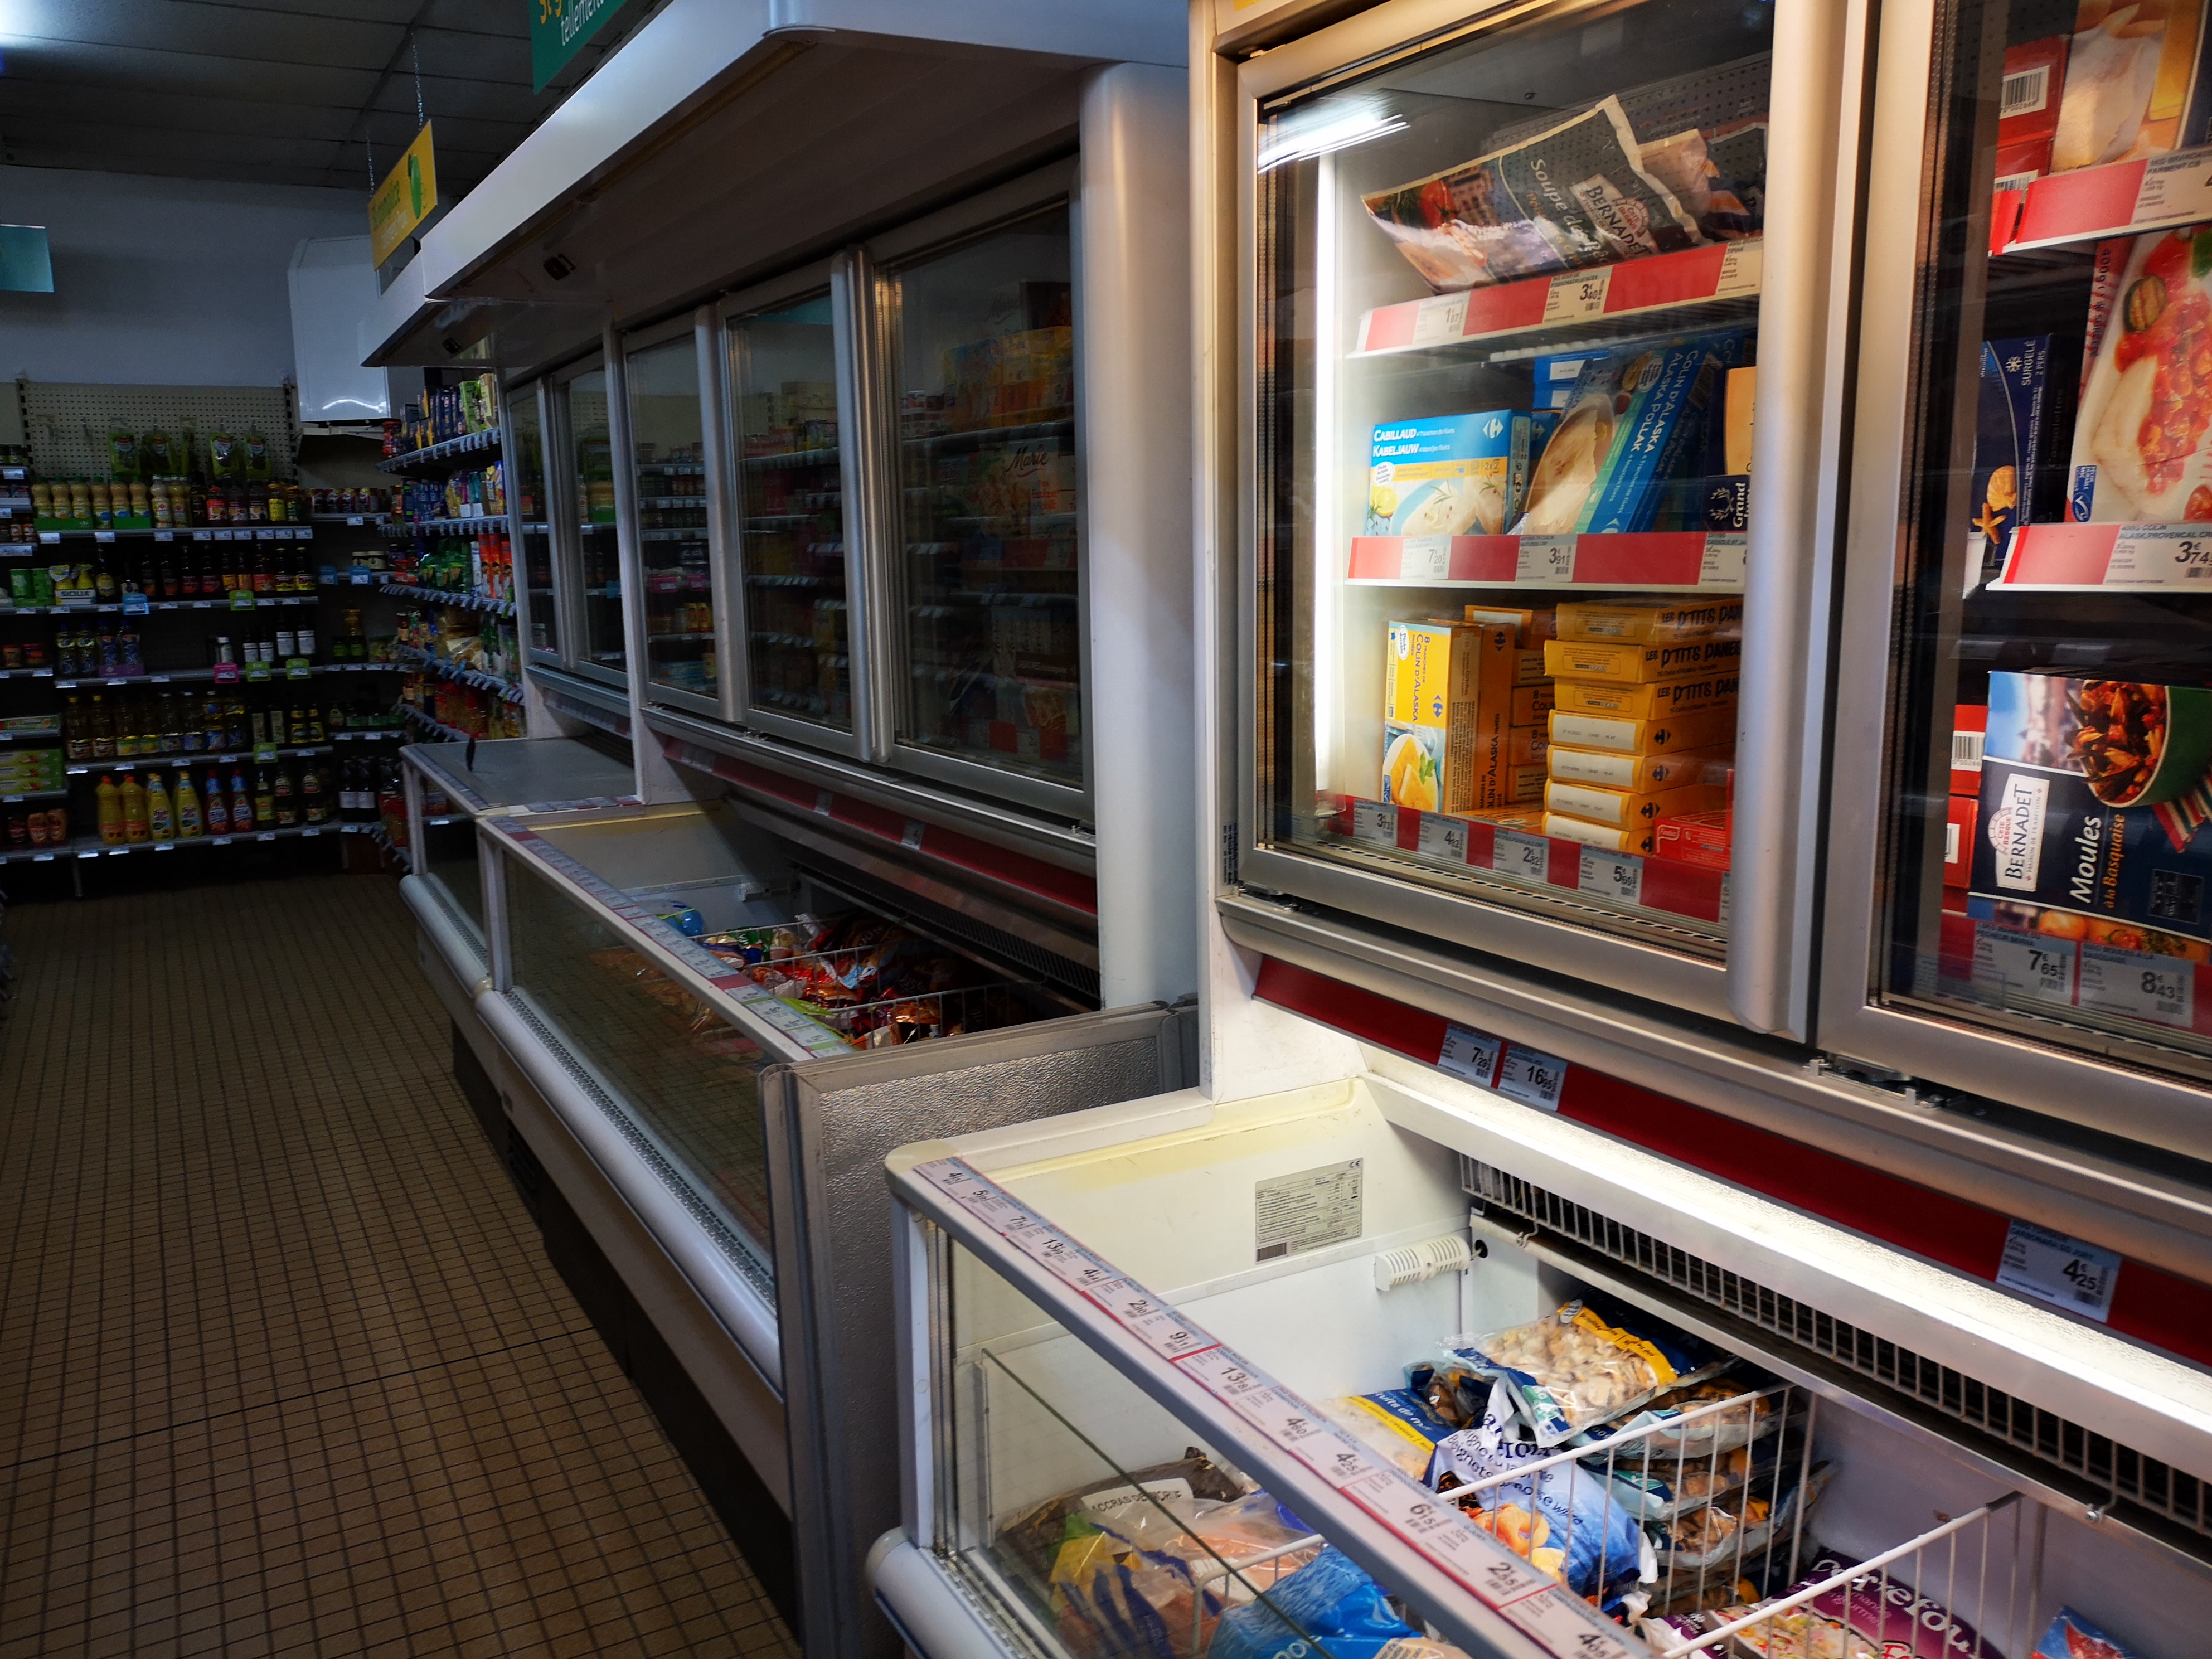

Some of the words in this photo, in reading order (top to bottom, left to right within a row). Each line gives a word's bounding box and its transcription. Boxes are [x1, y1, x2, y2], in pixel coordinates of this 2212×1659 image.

[1531, 159, 1568, 211] Soupe
[1586, 185, 1653, 255] BERNADET
[1654, 352, 1684, 400] ALASKA
[1672, 349, 1698, 388] COLIN
[2021, 339, 2036, 387] SURGELÉ
[1374, 428, 1417, 442] CABILLAUD
[1631, 402, 1661, 452] POLLAK
[1643, 390, 1680, 453] D'ALASKA
[1372, 443, 1420, 457] KABELJAUW
[1732, 481, 1746, 528] Grand
[1414, 633, 1425, 668] COLIN
[1411, 669, 1421, 722] D'ALASKA
[1488, 736, 1498, 785] D'ALASKA
[2002, 817, 2012, 845] BASQUE
[2004, 784, 2032, 880] BERNADET
[2031, 796, 2041, 835] TRADITION
[2069, 816, 2102, 904] Moules
[2102, 814, 2126, 887] Basquaise
[2103, 890, 2117, 900] la
